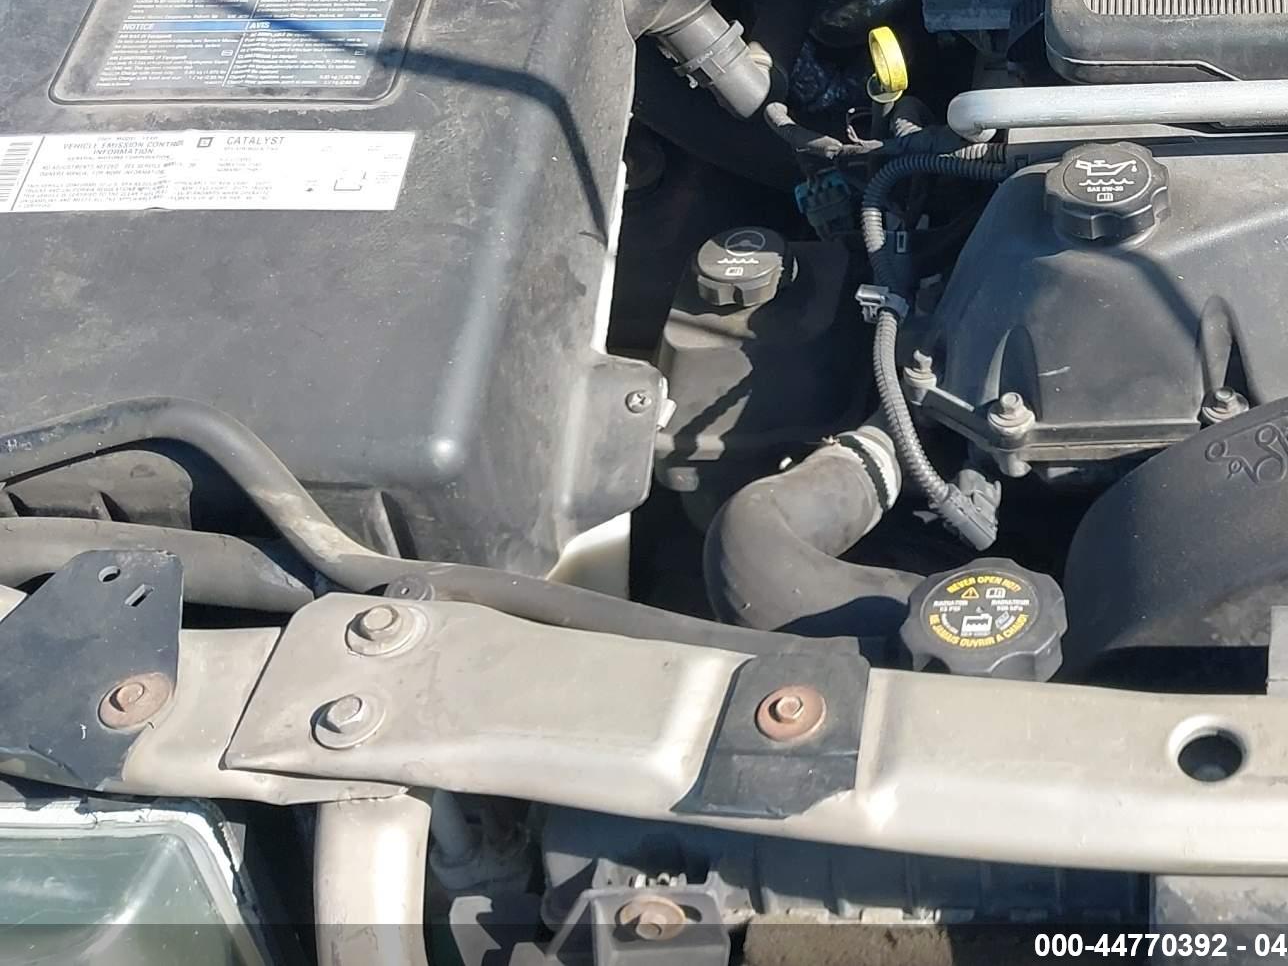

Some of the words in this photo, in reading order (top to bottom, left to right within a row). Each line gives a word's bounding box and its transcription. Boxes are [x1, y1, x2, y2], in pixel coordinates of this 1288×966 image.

[102, 141, 144, 149] EMISSION
[226, 136, 285, 145] CATALYST
[946, 577, 977, 594] NEVER
[977, 575, 1003, 585] OPEN
